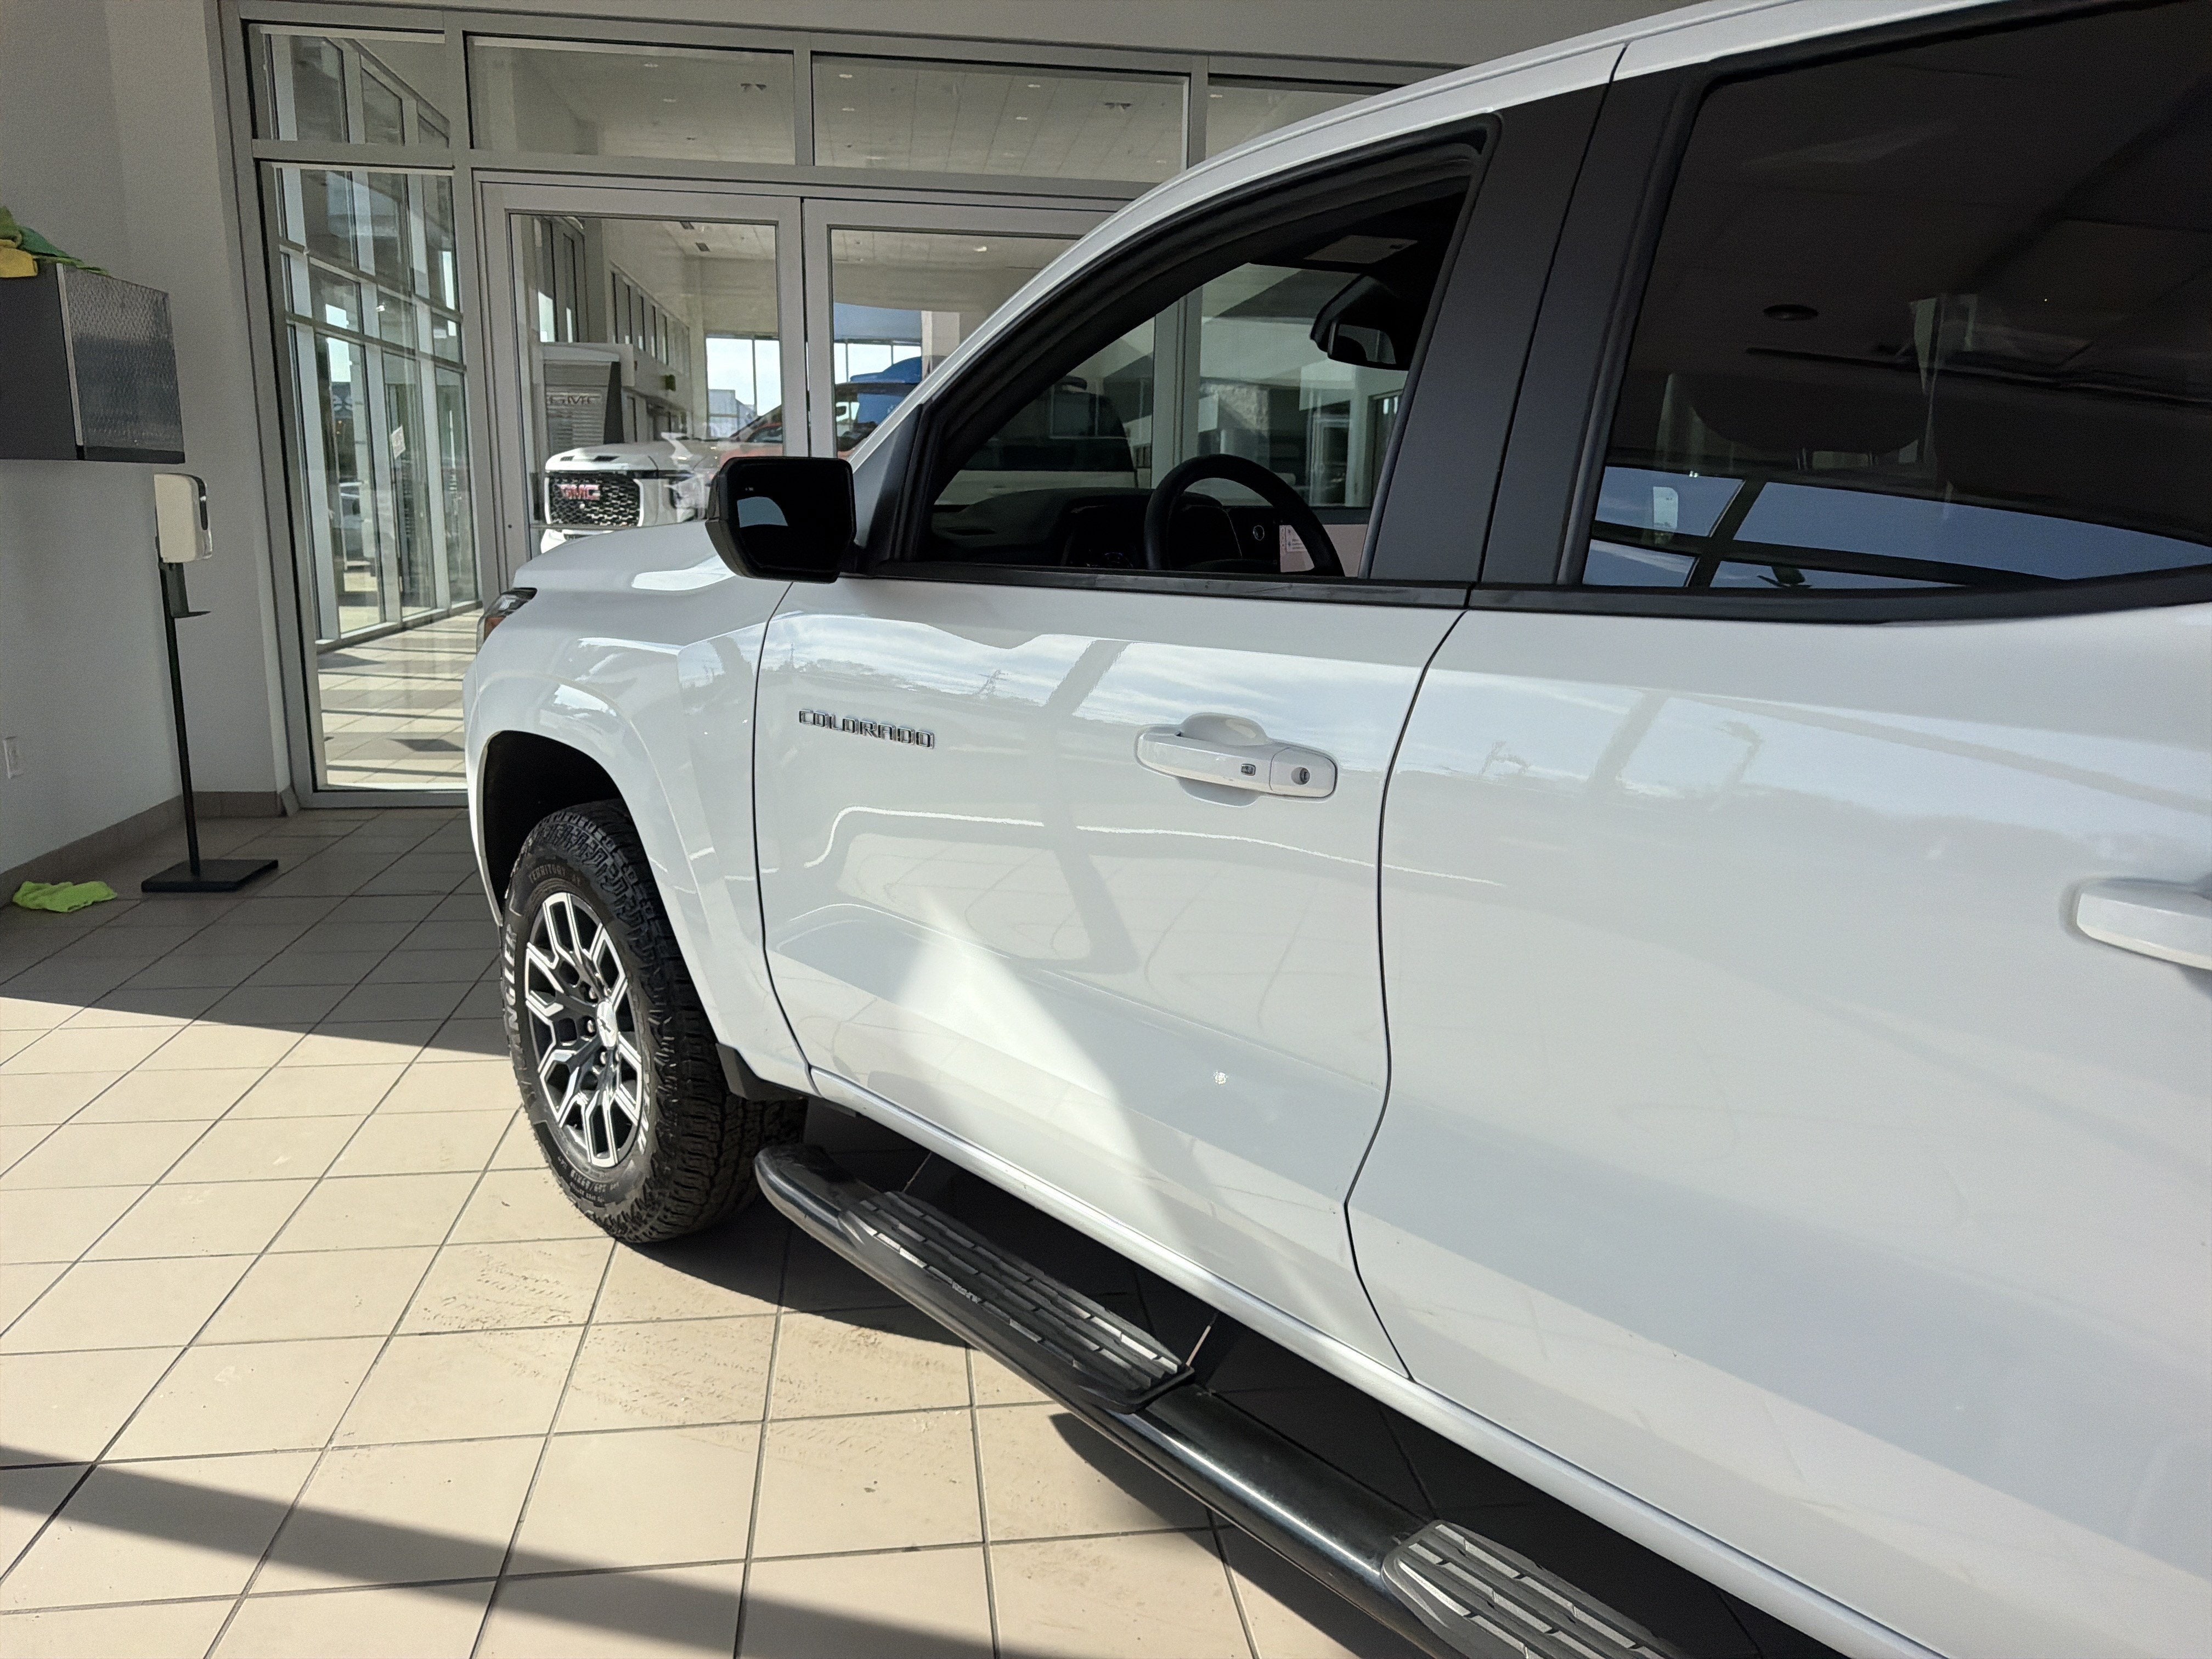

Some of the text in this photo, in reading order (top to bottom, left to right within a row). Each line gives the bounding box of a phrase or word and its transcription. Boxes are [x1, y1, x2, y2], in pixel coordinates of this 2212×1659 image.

[558, 484, 601, 500] GMC
[798, 709, 935, 749] COLORADO
[528, 864, 566, 884] TERRITORY
